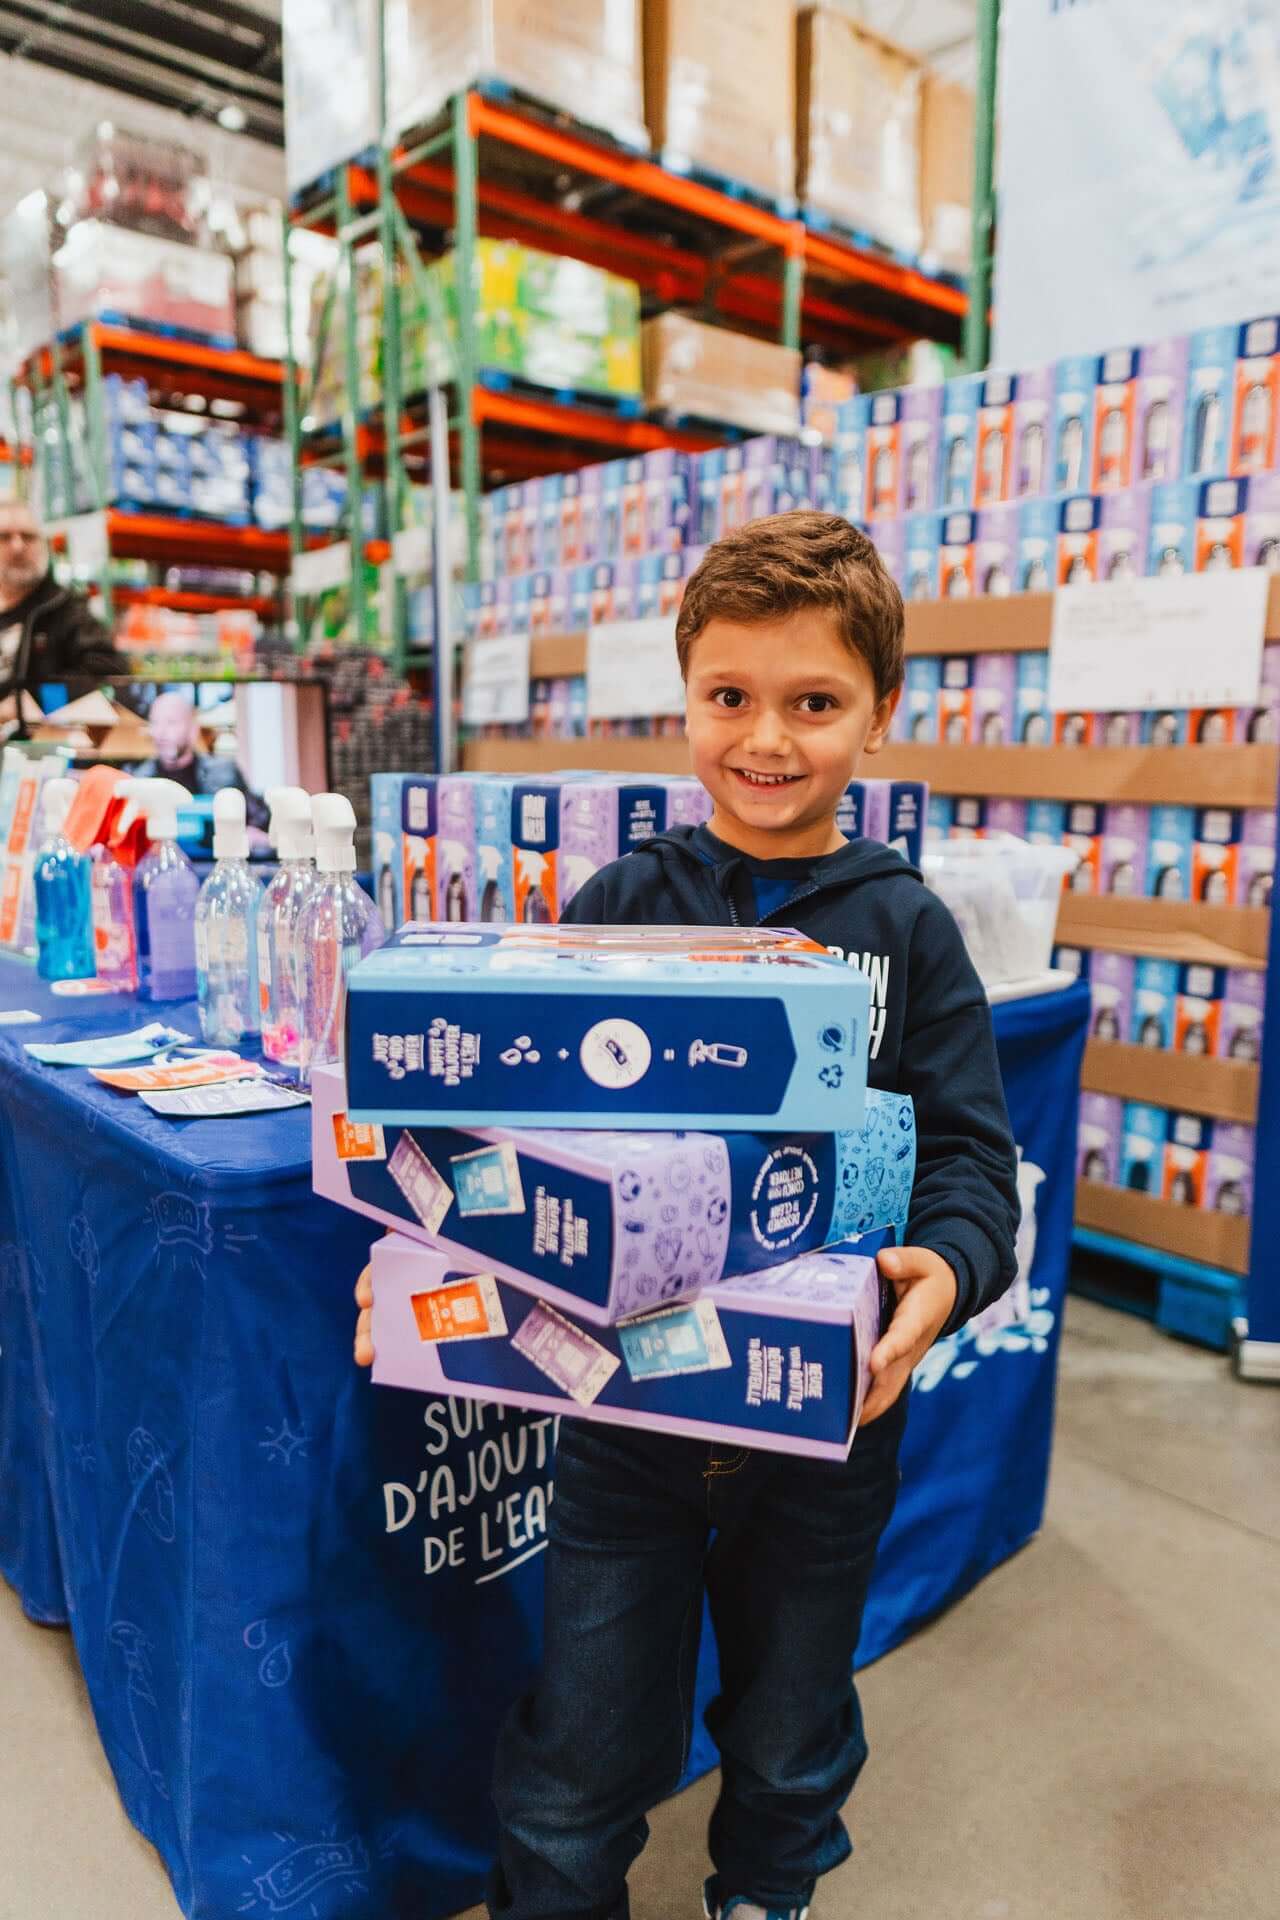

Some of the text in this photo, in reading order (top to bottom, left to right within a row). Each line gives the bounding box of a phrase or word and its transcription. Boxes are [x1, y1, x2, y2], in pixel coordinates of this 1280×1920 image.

[405, 1034, 421, 1071] WATER
[746, 1348, 763, 1406] BOUTEILLE
[787, 1368, 803, 1411] BOTTLE
[383, 1412, 562, 1534] D'AJOUT
[424, 1526, 466, 1575] DE
